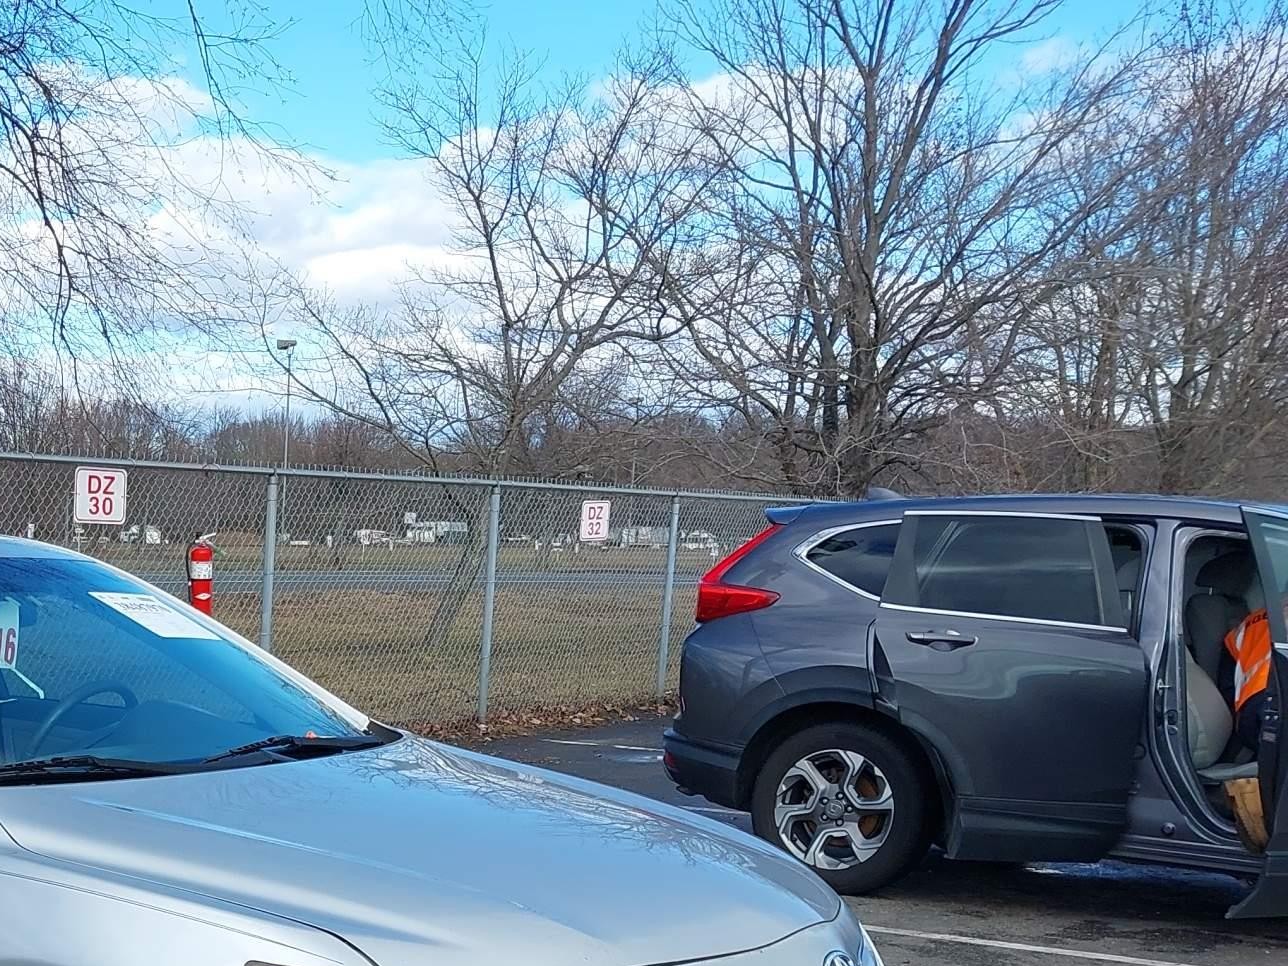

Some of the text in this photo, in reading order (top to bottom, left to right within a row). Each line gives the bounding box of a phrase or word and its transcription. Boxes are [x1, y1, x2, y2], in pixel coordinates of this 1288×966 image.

[87, 475, 116, 495] DZ
[88, 497, 114, 516] 30
[588, 506, 604, 520] DZ
[587, 522, 602, 536] 32
